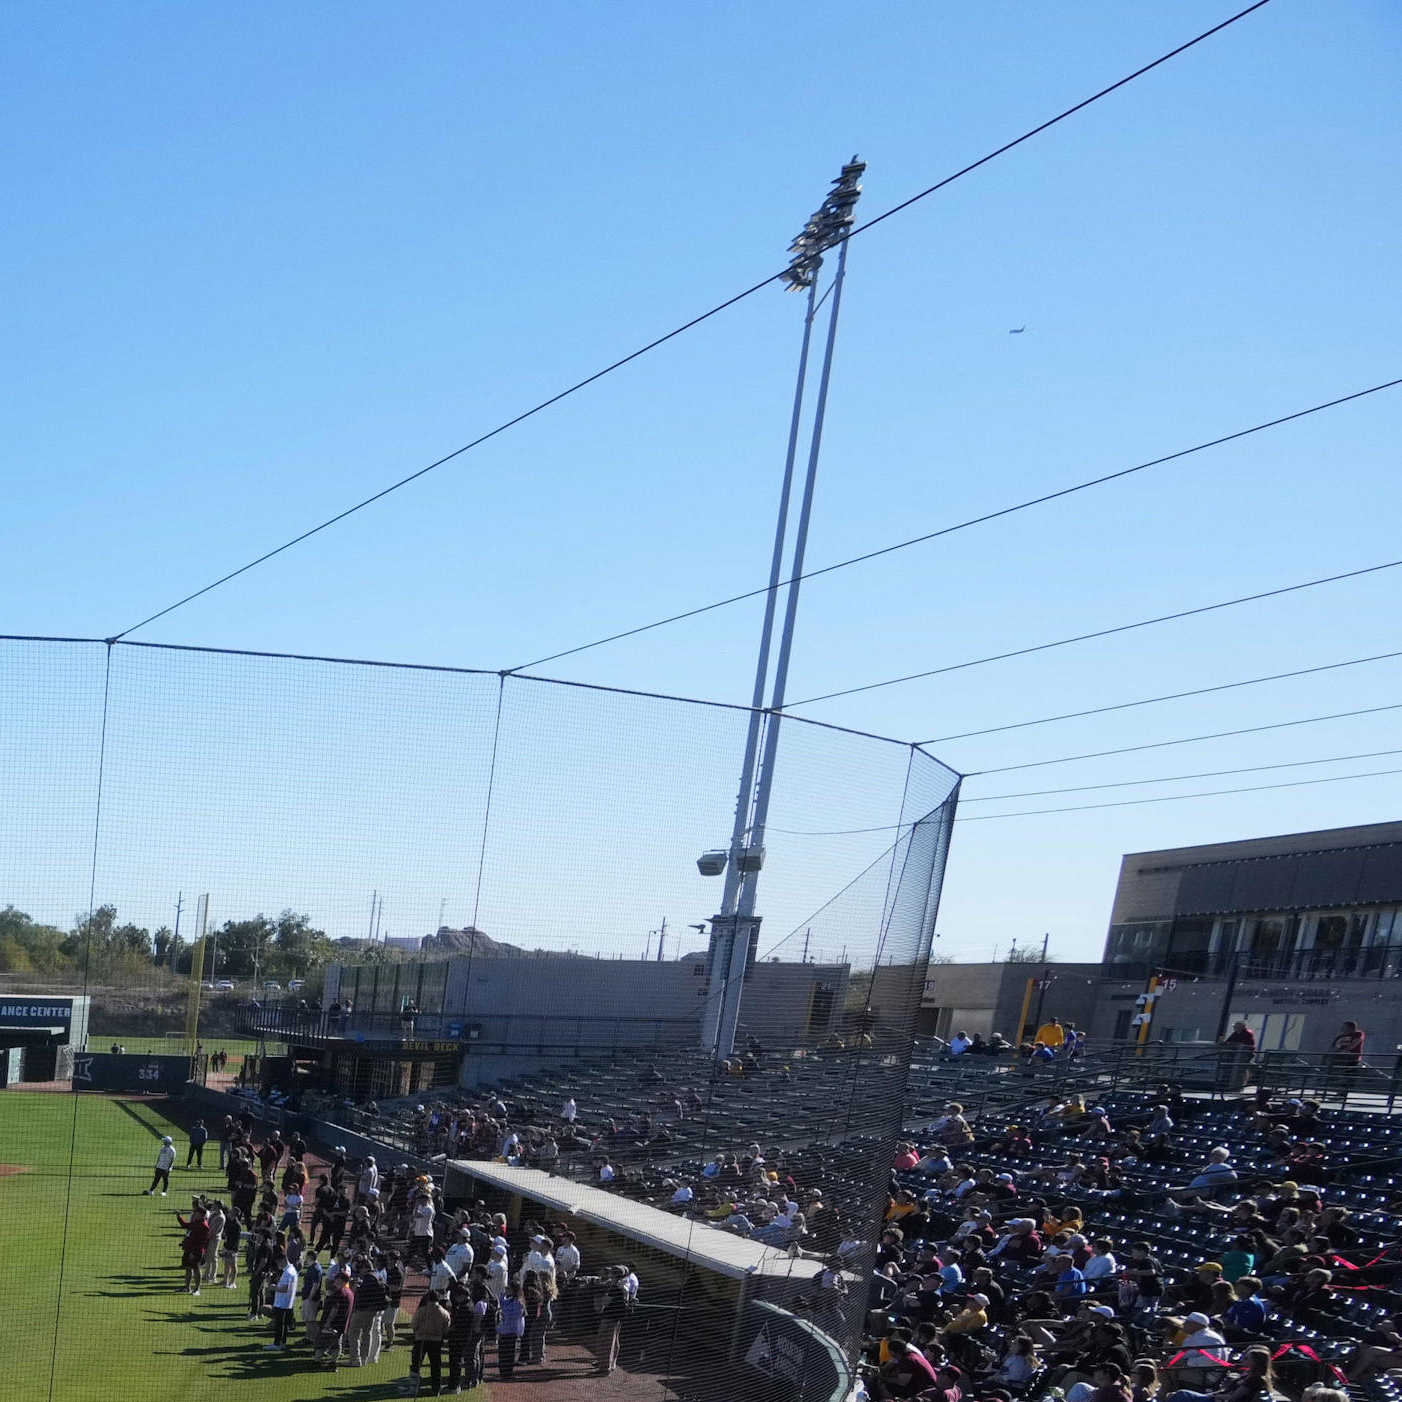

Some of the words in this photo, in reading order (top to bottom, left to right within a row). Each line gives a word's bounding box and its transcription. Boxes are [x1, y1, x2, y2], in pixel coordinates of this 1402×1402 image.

[1039, 980, 1052, 990] 17
[1162, 979, 1177, 991] 15
[29, 1007, 71, 1017] CENTER
[138, 1069, 160, 1080] 334
